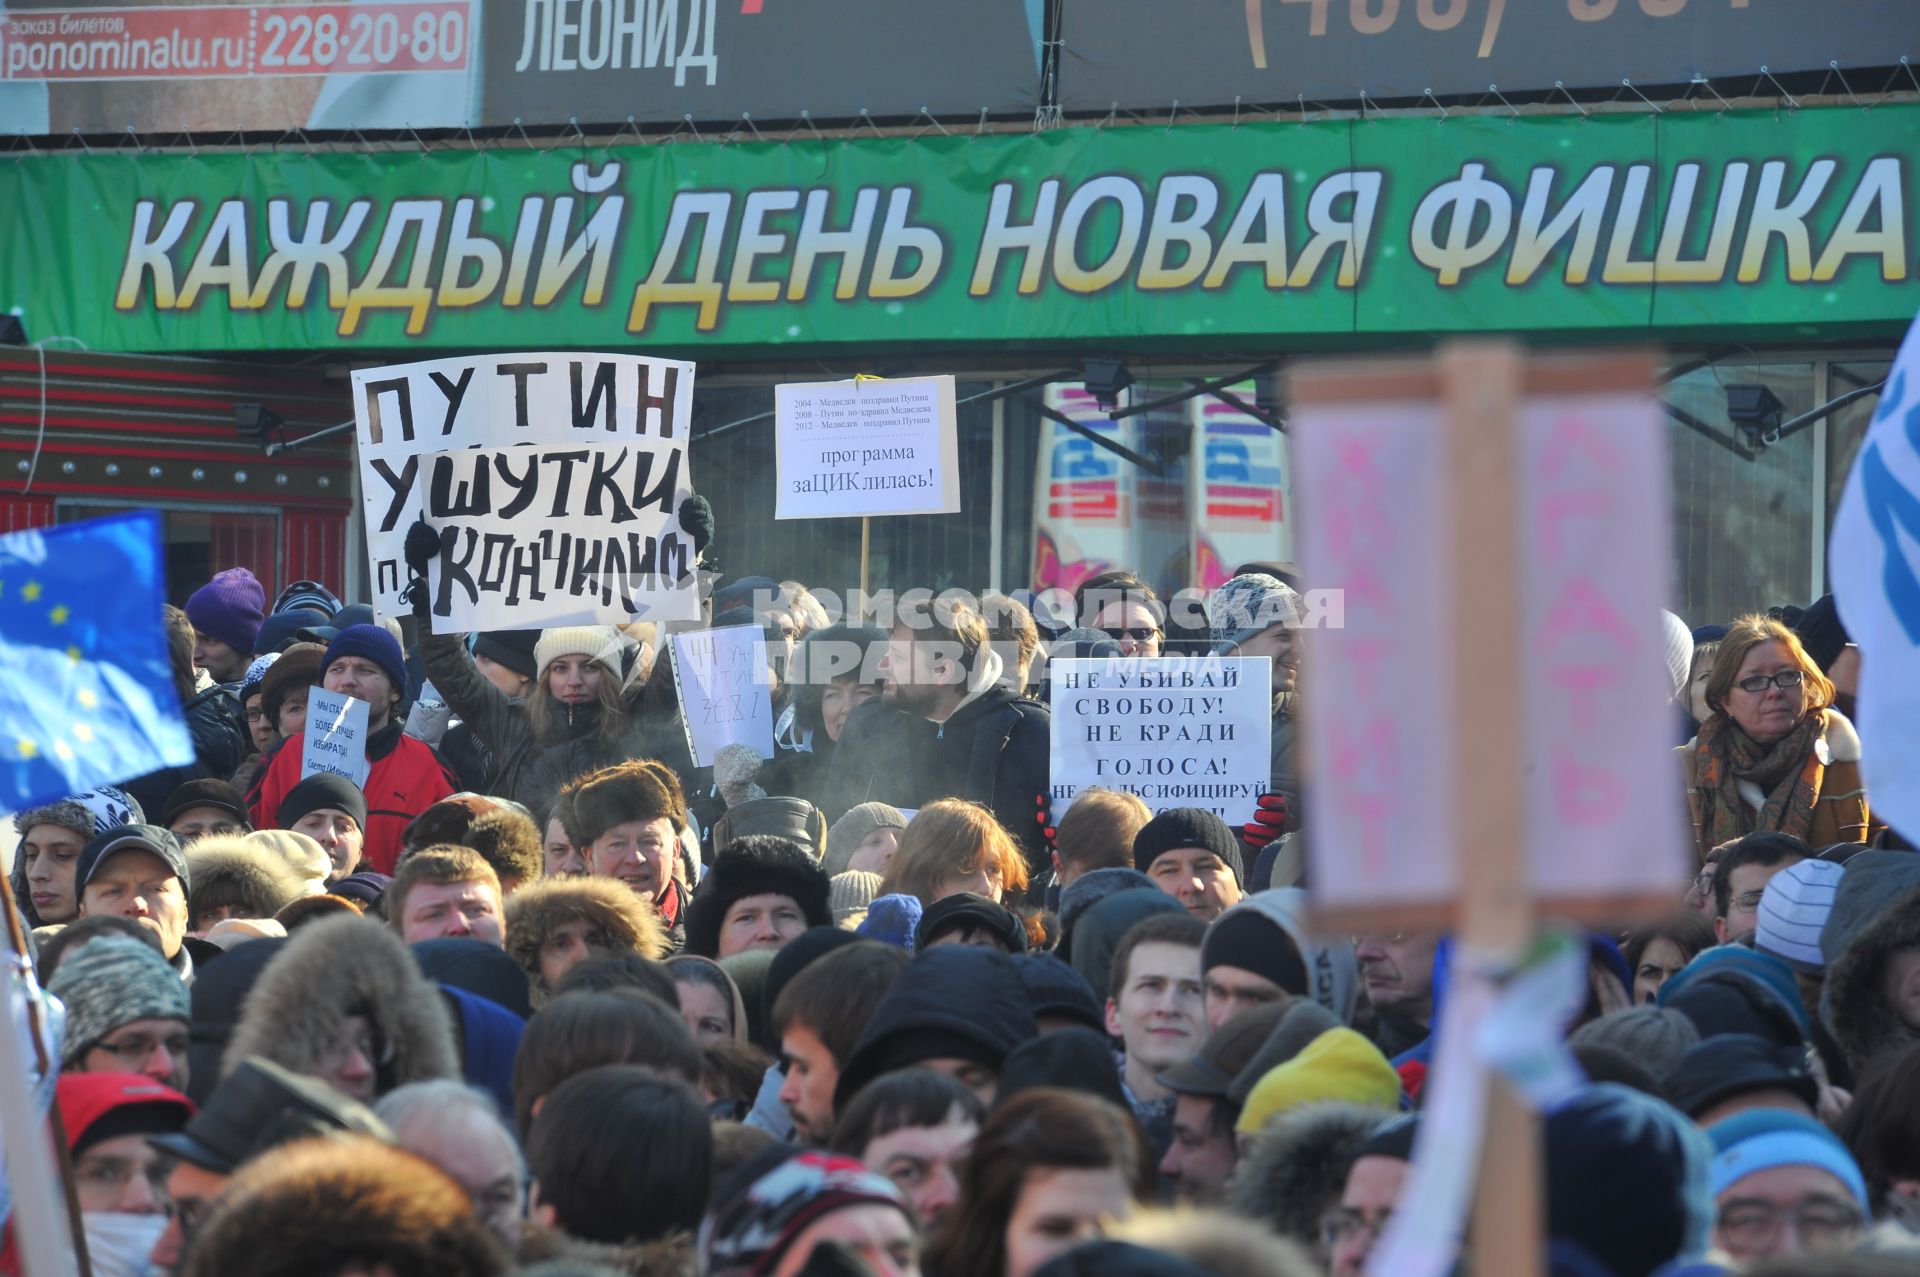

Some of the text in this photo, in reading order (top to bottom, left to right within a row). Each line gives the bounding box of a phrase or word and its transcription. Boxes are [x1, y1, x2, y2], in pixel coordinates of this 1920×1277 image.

[10, 15, 124, 36] заказ билетов
[516, 0, 717, 86] ЛЕОНИД
[8, 32, 243, 79] ponominalu.ru
[115, 156, 1907, 335] КАЖДЫЙ ДЕНЬ НОВАЯ ФИШКА
[364, 361, 679, 445] ПУТИН
[794, 399, 812, 408] 2004
[819, 398, 856, 408] Медведев
[861, 396, 900, 408] поздравил
[901, 394, 929, 404] Путина
[794, 410, 812, 420] 2008
[820, 409, 844, 420] Путин
[891, 405, 931, 415] Медведева
[795, 421, 813, 431] 2012
[821, 420, 858, 430] Медведев
[863, 418, 901, 429] поздравил
[902, 416, 931, 427] Путина
[821, 447, 915, 467] программа
[430, 446, 682, 524] ШУТКИ
[433, 524, 695, 618] КОНЧИЛИСЬ
[1064, 667, 1239, 689] НЕ УБИВАЙ
[1075, 697, 1224, 718] СВОБОДУ!
[1086, 723, 1236, 744] НЕ КРАДИ
[1096, 757, 1228, 776] ГОЛОСА!
[1053, 784, 1078, 799] НЕ
